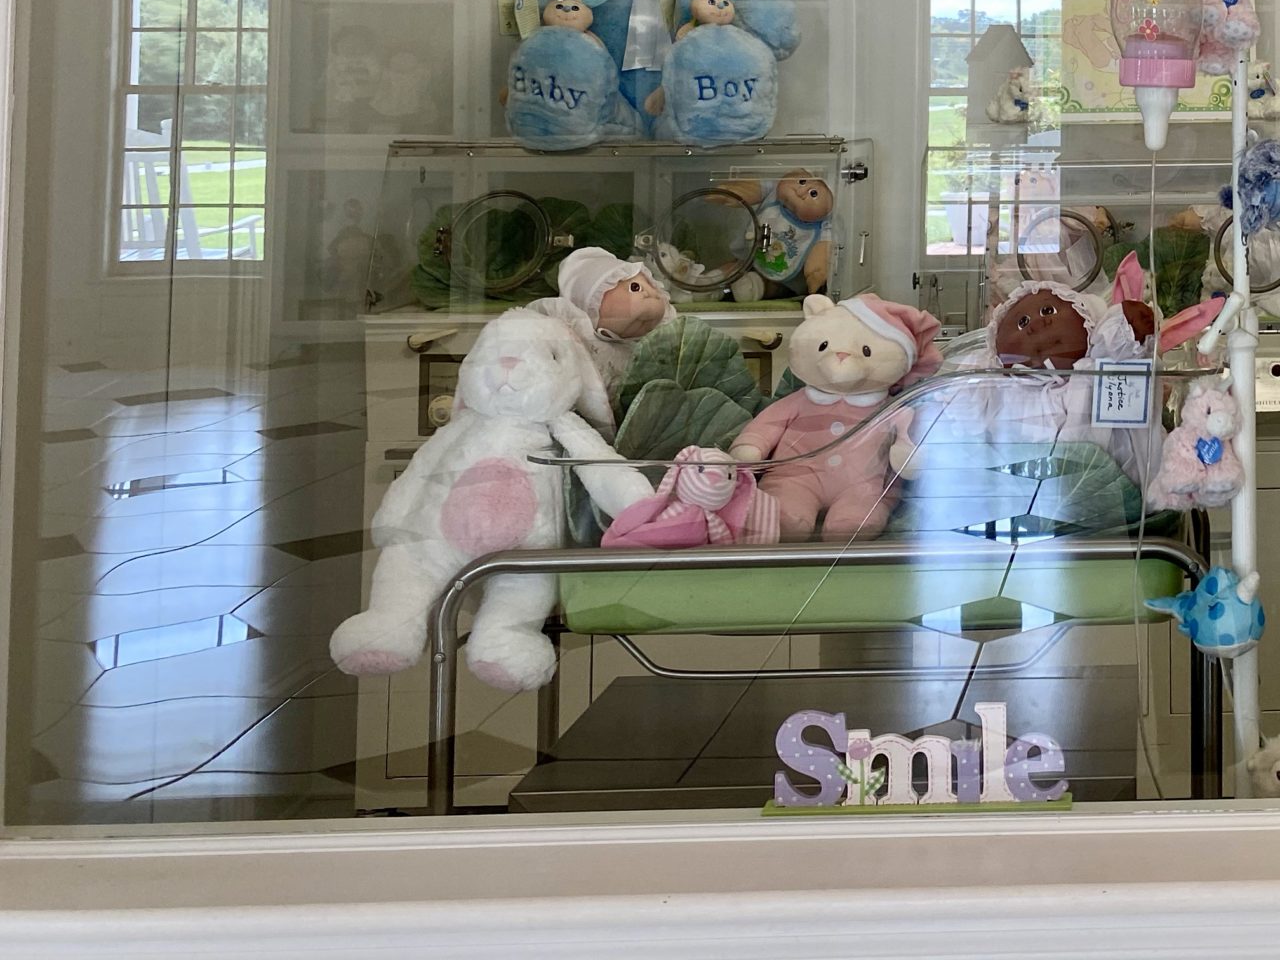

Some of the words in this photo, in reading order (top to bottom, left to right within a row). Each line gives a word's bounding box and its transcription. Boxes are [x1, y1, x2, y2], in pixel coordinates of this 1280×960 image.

[513, 66, 587, 110] Baby
[694, 75, 760, 102] Boy
[774, 701, 1070, 807] Smile
